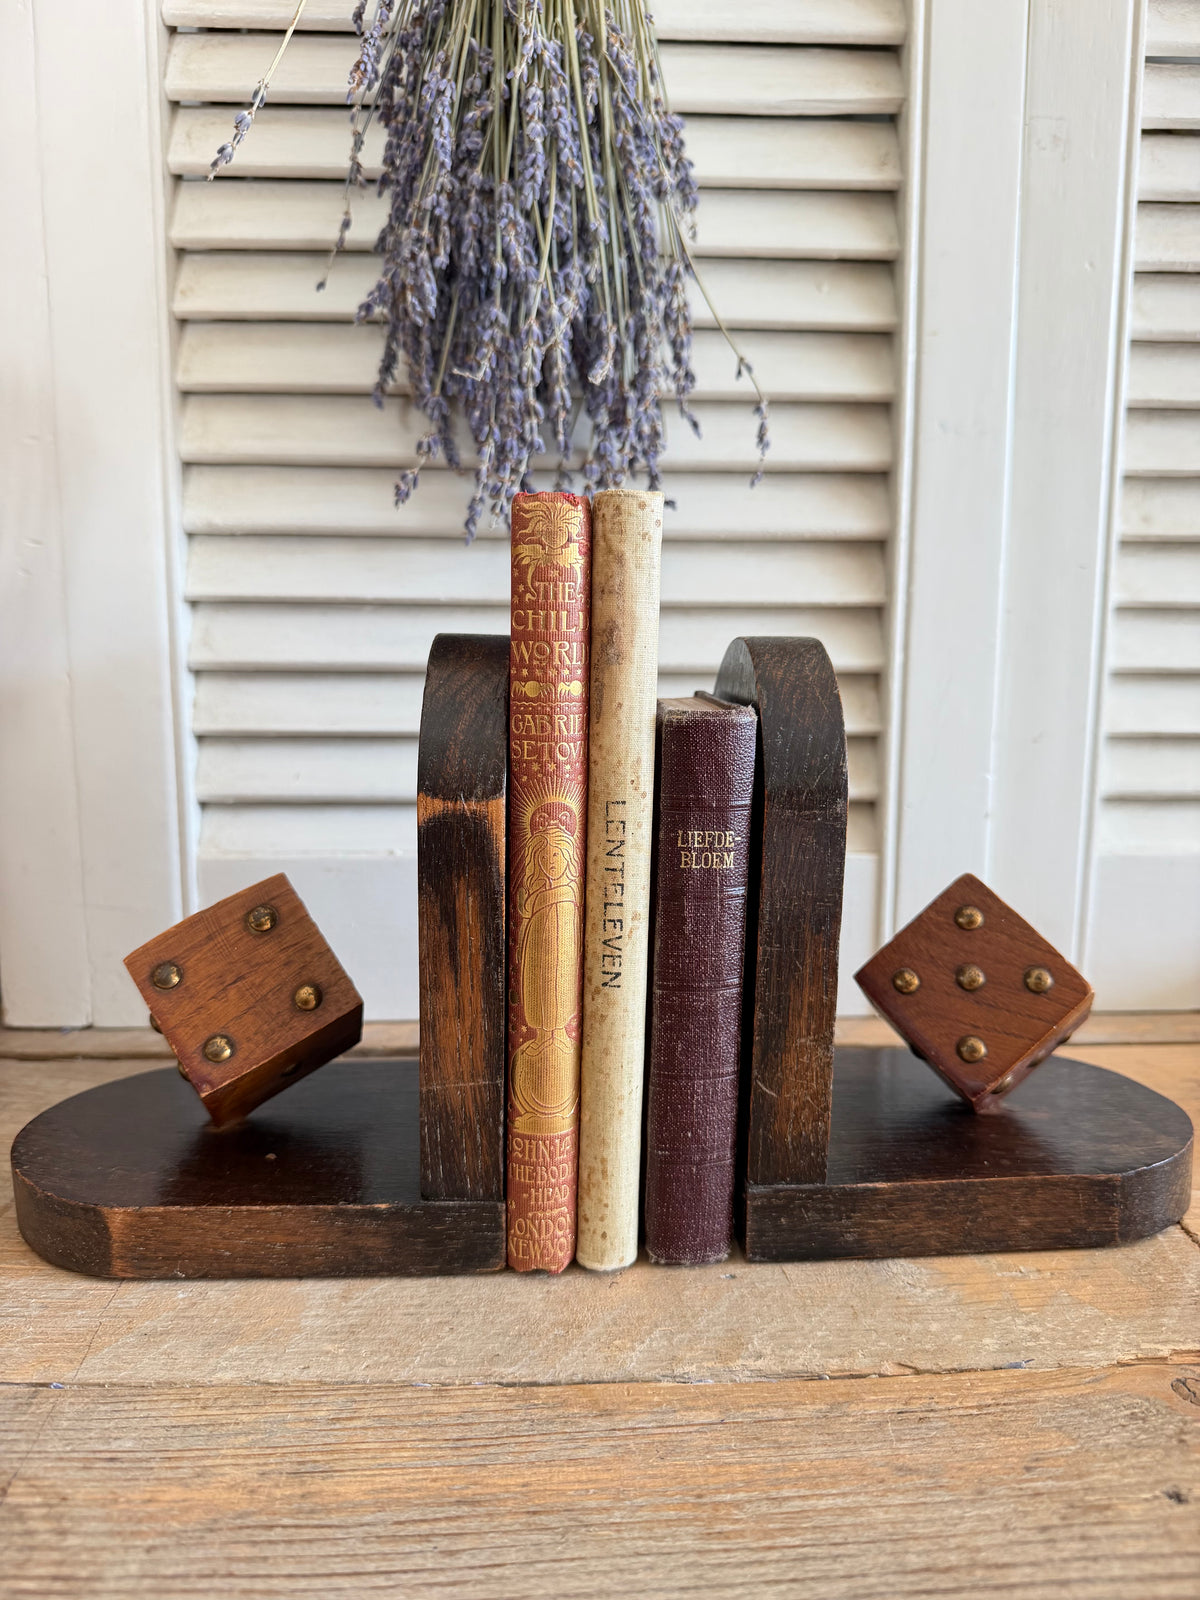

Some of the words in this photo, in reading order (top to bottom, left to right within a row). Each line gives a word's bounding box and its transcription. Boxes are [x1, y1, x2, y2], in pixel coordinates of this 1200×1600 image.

[535, 581, 576, 603] THE
[512, 609, 590, 632] CHILD
[677, 829, 742, 849] LIEFDE-
[679, 850, 736, 870] BLOEM
[601, 799, 627, 990] LENTELEVEN
